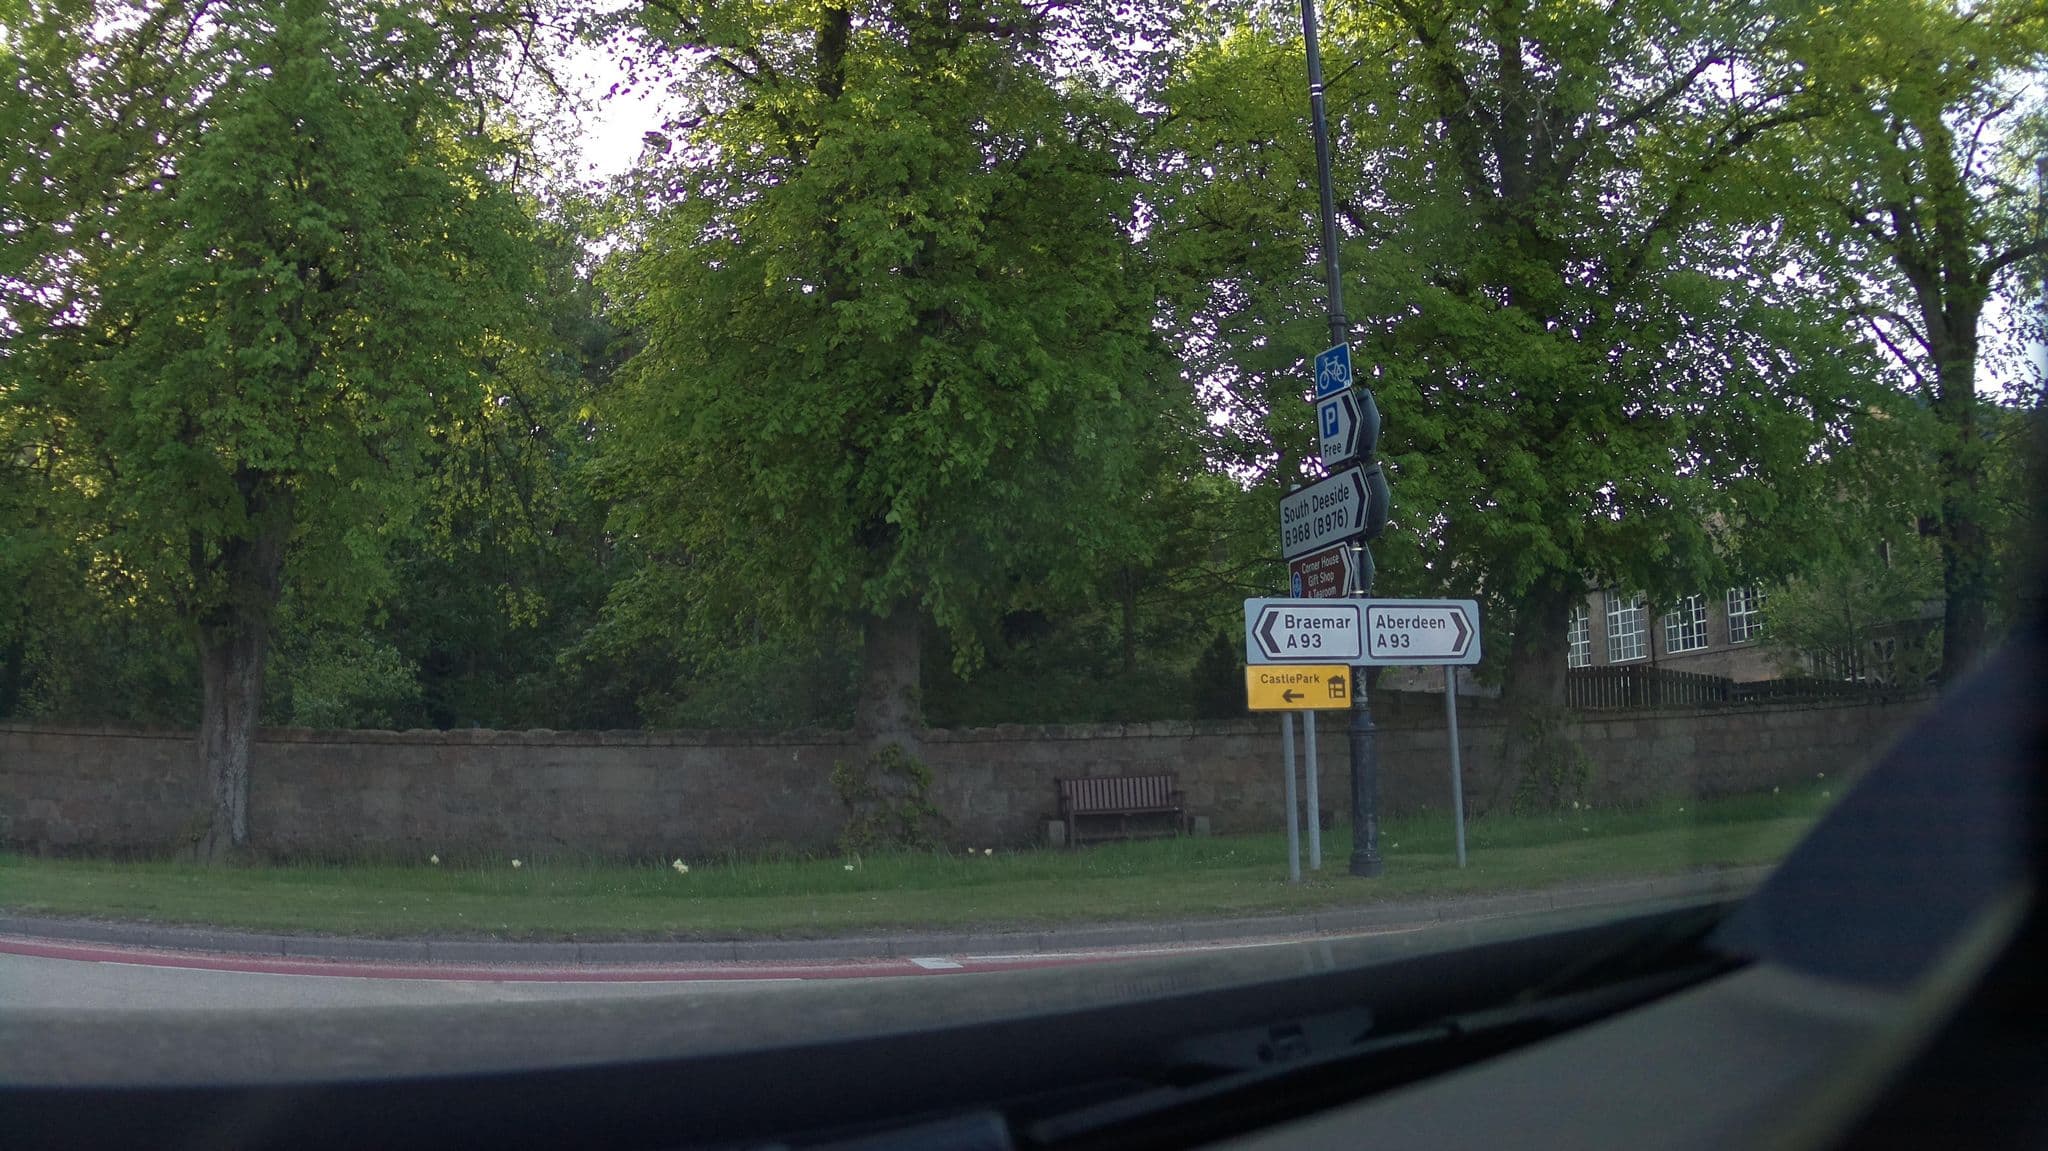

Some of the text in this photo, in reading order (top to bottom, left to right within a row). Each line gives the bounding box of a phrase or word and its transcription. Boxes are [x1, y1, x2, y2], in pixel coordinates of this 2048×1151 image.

[1325, 407, 1336, 435] P
[1324, 442, 1342, 458] Free
[1284, 483, 1350, 524] South Deeside
[1285, 506, 1348, 547] B968 (B976)
[1301, 554, 1340, 574] Corner House
[1308, 571, 1335, 587] Gift Shop
[1284, 614, 1351, 629] Braemar
[1375, 614, 1446, 629] Aberdeen
